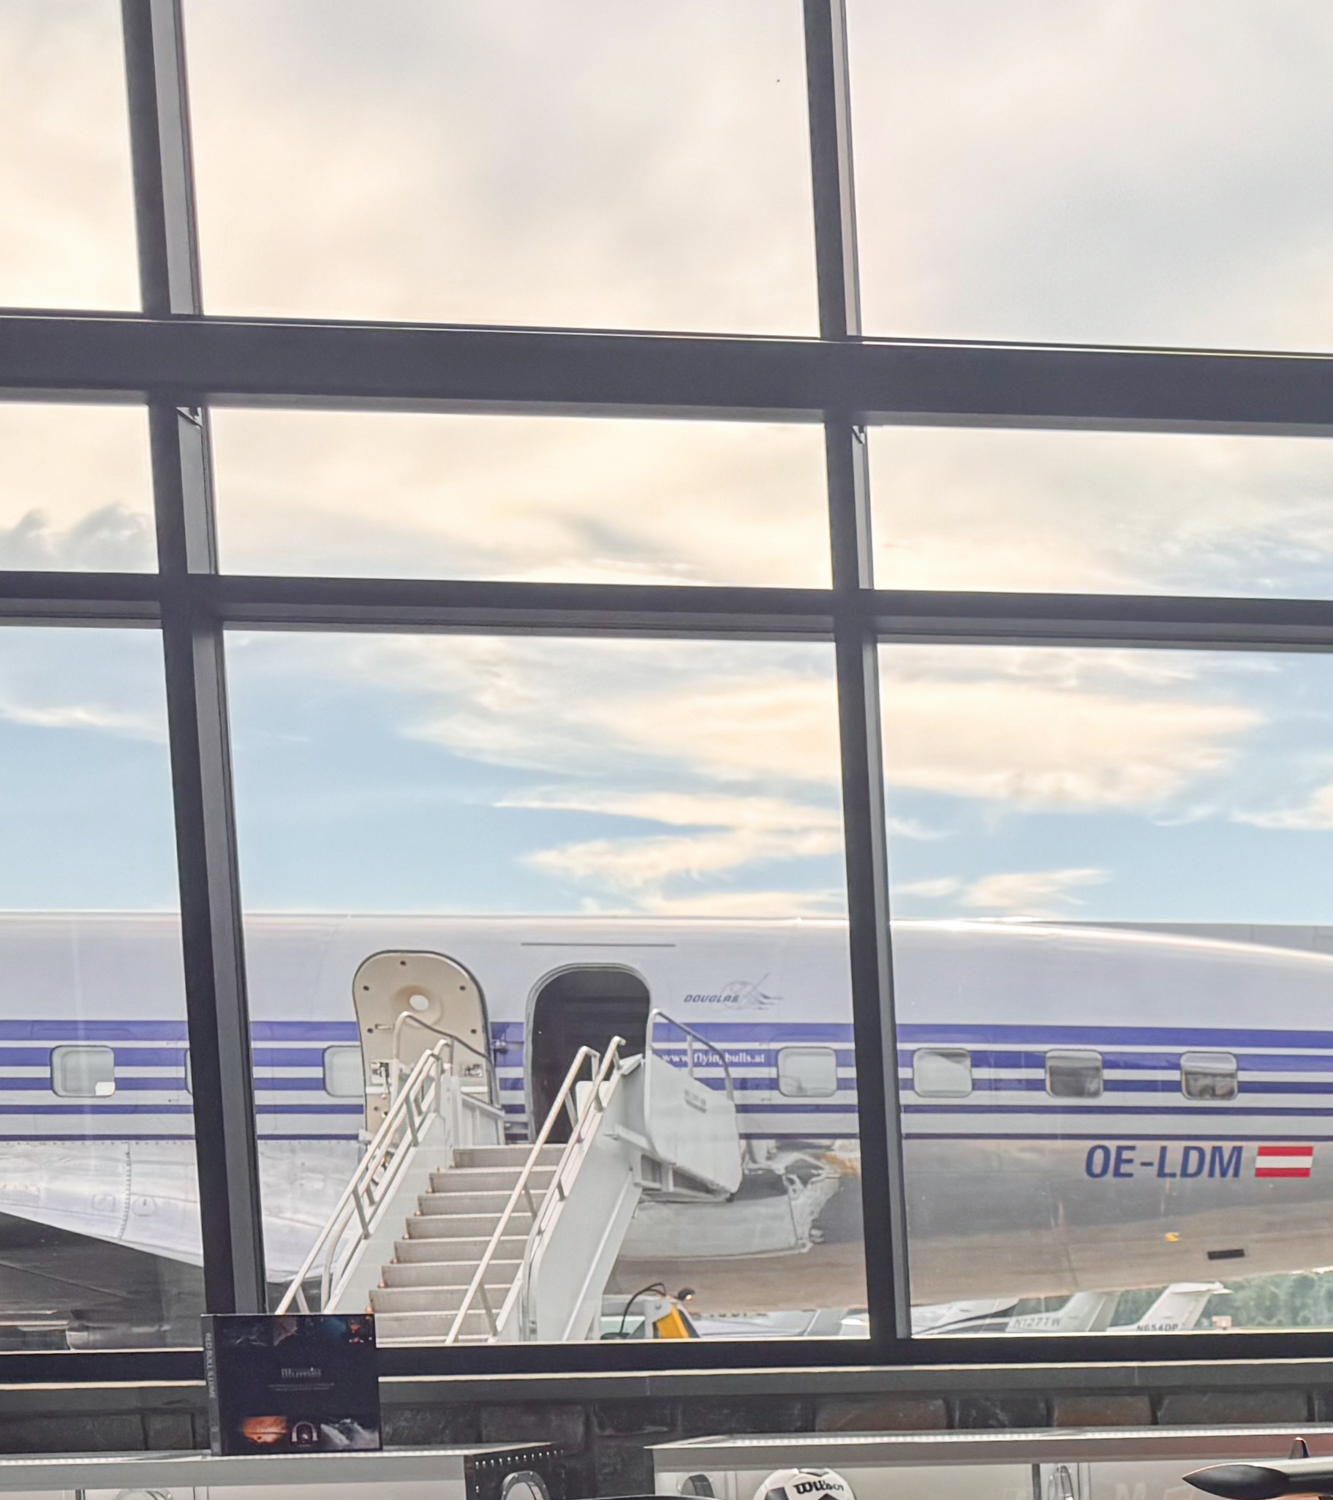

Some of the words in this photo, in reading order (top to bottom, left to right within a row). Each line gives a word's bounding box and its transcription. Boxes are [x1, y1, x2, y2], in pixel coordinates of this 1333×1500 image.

[683, 994, 741, 1003] DOUGLAS
[1084, 1144, 1243, 1179] OE-LDM
[793, 1480, 845, 1495] Wilson
